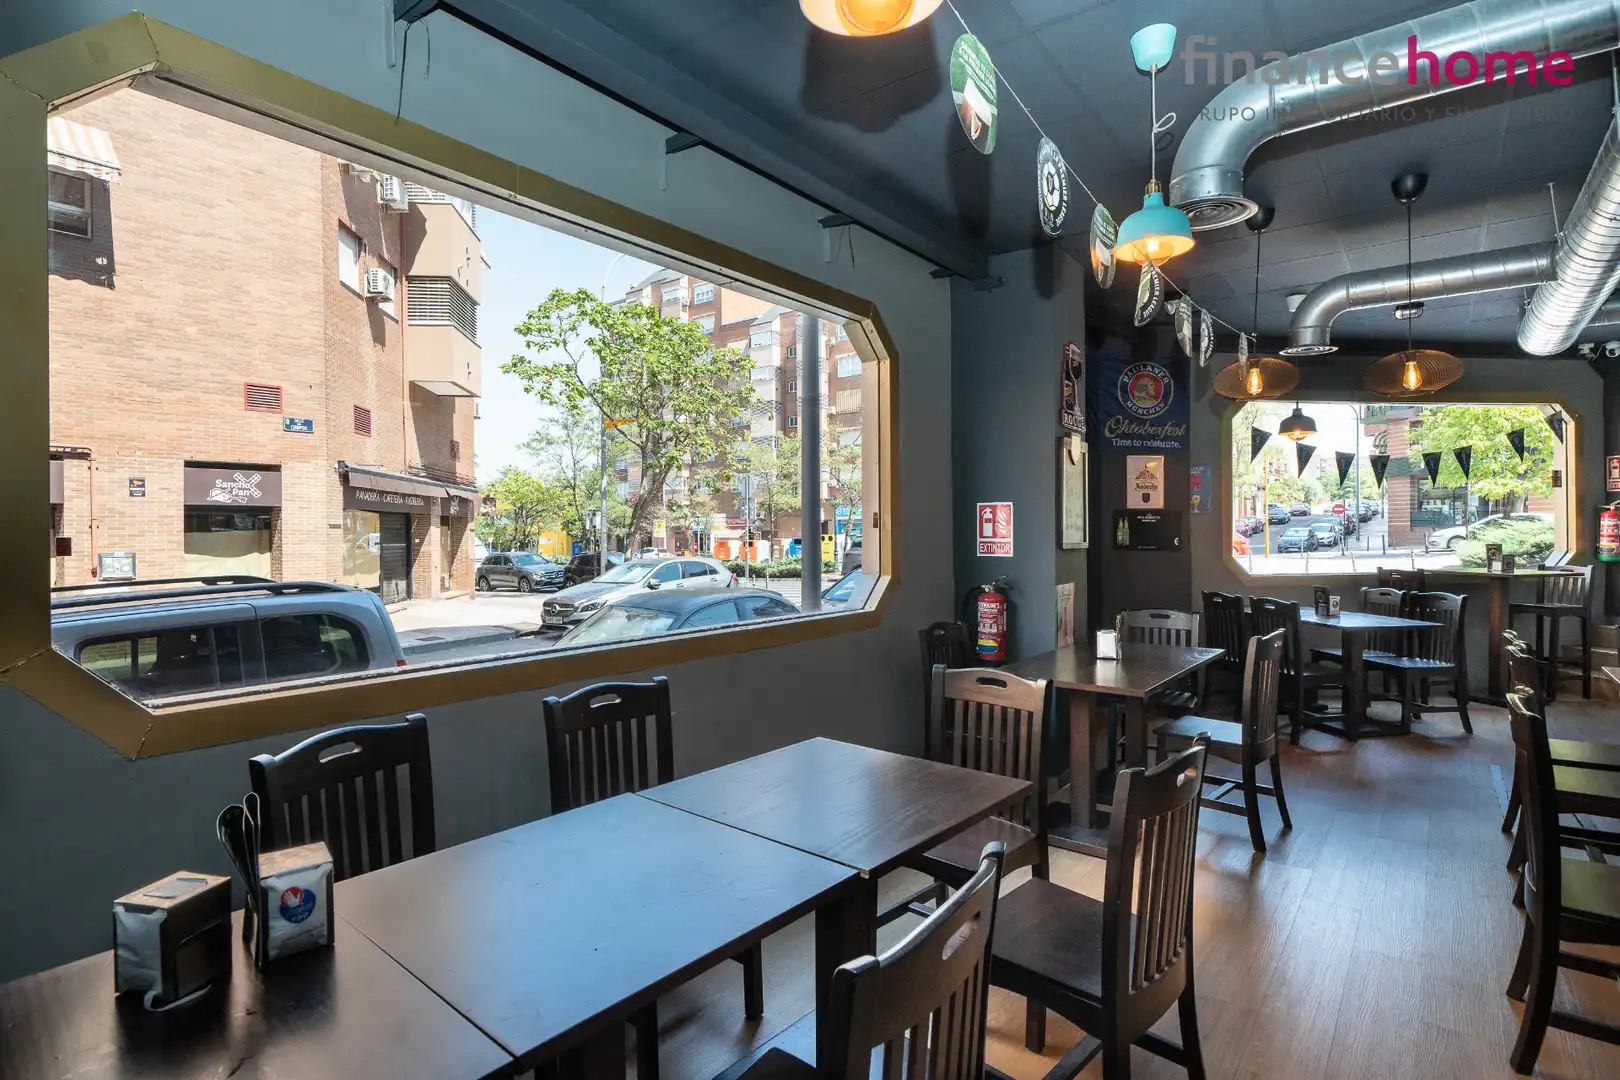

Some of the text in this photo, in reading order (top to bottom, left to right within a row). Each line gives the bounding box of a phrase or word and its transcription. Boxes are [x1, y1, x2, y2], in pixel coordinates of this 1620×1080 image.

[1123, 365, 1170, 384] PAULANER
[1105, 415, 1187, 440] Oktoberfest
[1111, 438, 1133, 447] Time
[1133, 439, 1142, 447] to
[215, 479, 251, 489] Sancho
[232, 488, 250, 497] Pan
[979, 542, 1011, 553] EXTINTOR
